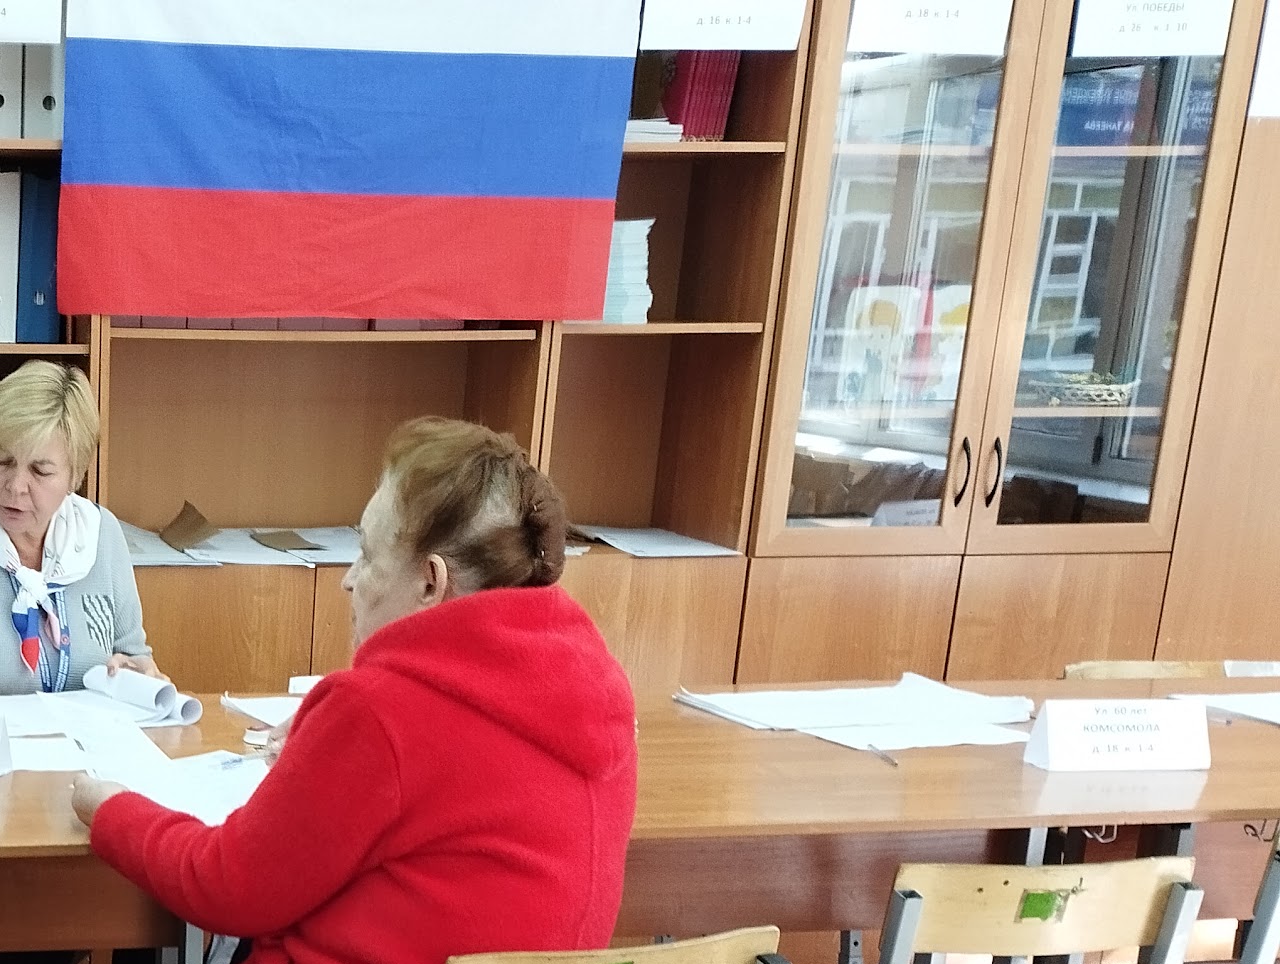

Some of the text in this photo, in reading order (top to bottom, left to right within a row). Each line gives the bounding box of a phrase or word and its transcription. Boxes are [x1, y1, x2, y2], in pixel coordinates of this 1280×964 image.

[1142, 2, 1185, 13] ПОБЕДЫ
[918, 8, 929, 18] 18
[946, 9, 960, 19] 1-4
[709, 15, 721, 25] 16
[737, 15, 751, 25] 1-4
[1165, 22, 1188, 32] 110
[1114, 706, 1127, 716] 60
[1130, 707, 1147, 715] лет
[1083, 723, 1160, 733] КОМСОМОЛА
[1107, 744, 1119, 753] 18
